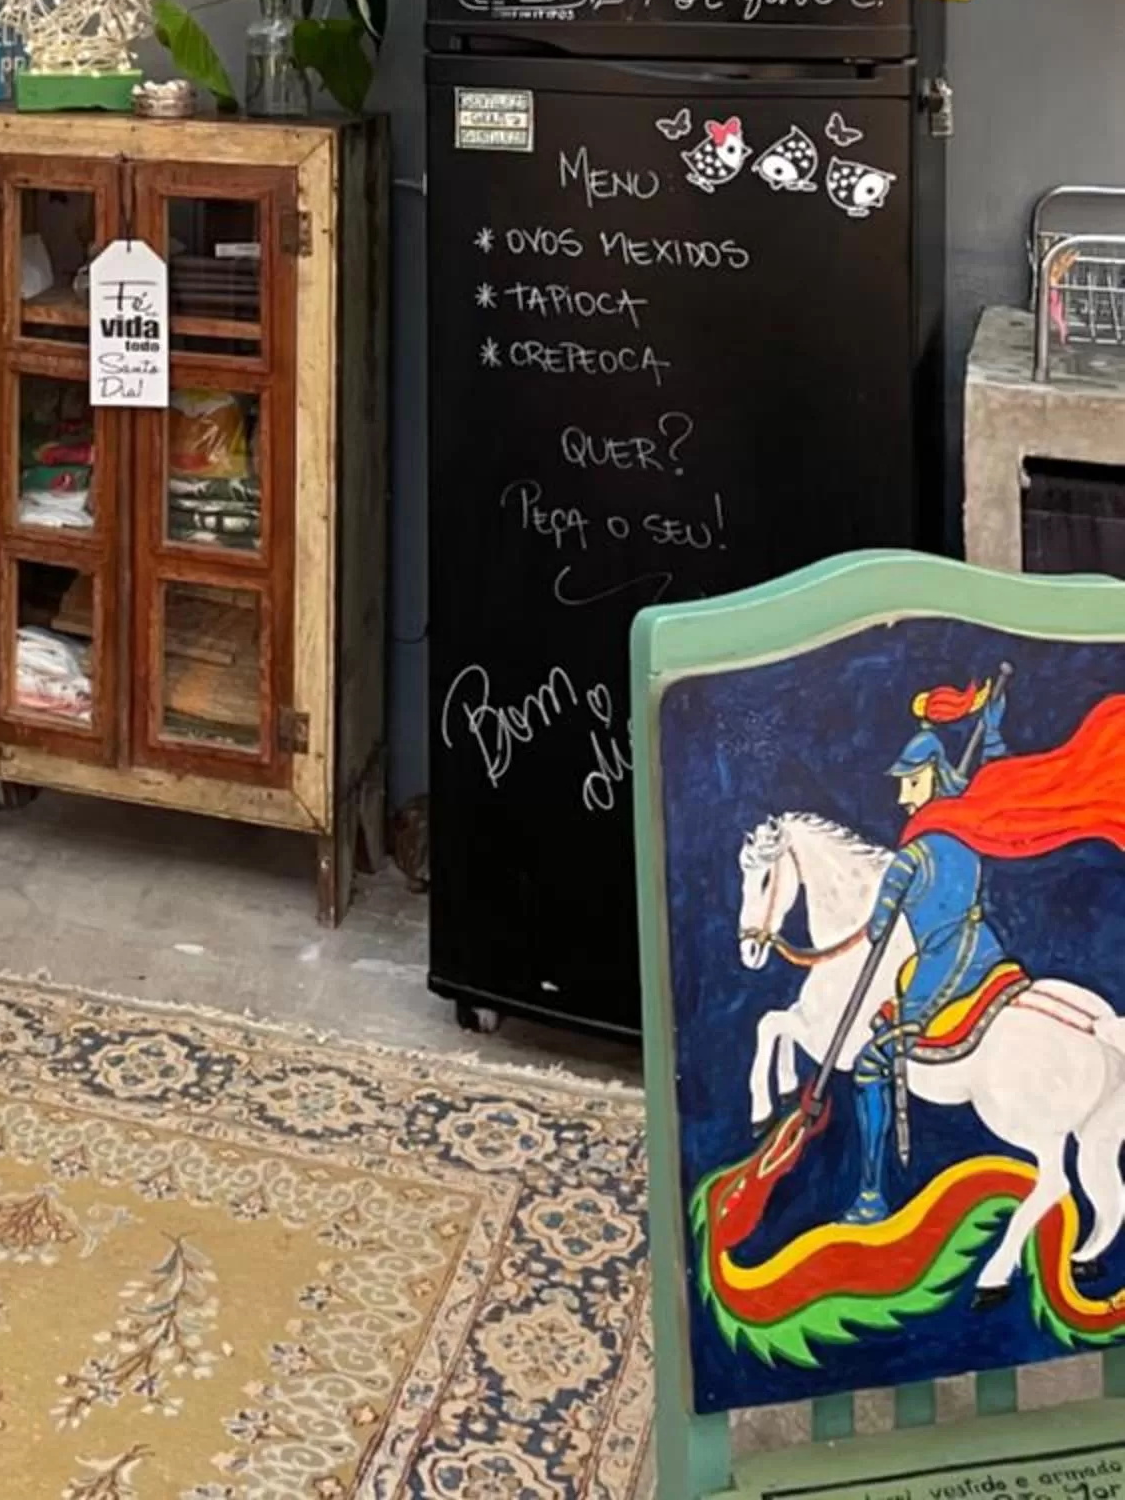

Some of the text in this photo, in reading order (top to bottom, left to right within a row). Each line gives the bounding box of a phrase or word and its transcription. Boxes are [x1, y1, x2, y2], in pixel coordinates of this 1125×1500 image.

[507, 227, 749, 268] OVOS MEXIDOS
[101, 316, 160, 338] vida
[125, 341, 160, 352] todo
[561, 411, 693, 475] QUER?
